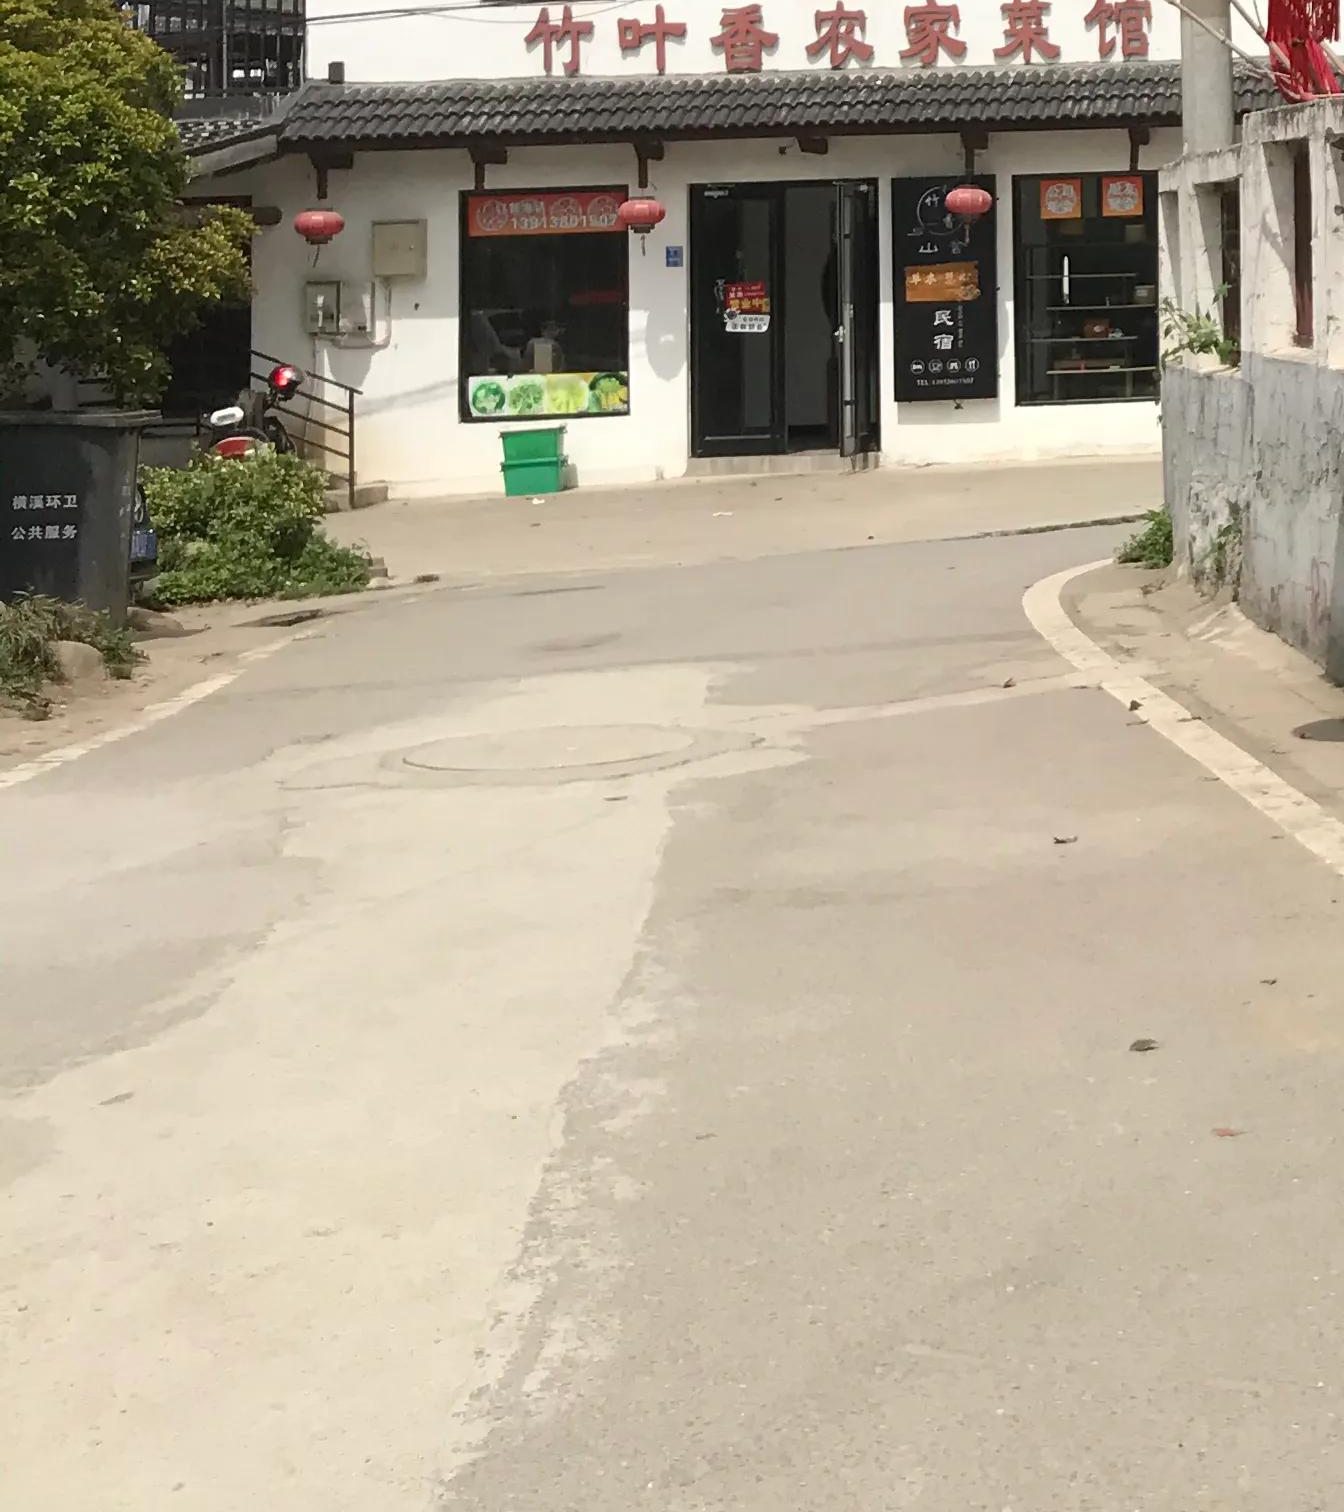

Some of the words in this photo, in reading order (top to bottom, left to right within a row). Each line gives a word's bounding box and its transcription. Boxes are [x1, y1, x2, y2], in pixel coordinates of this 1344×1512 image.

[933, 309, 954, 350] 民宿
[12, 494, 78, 511] 横溪环卫
[11, 524, 78, 540] 公共服务
